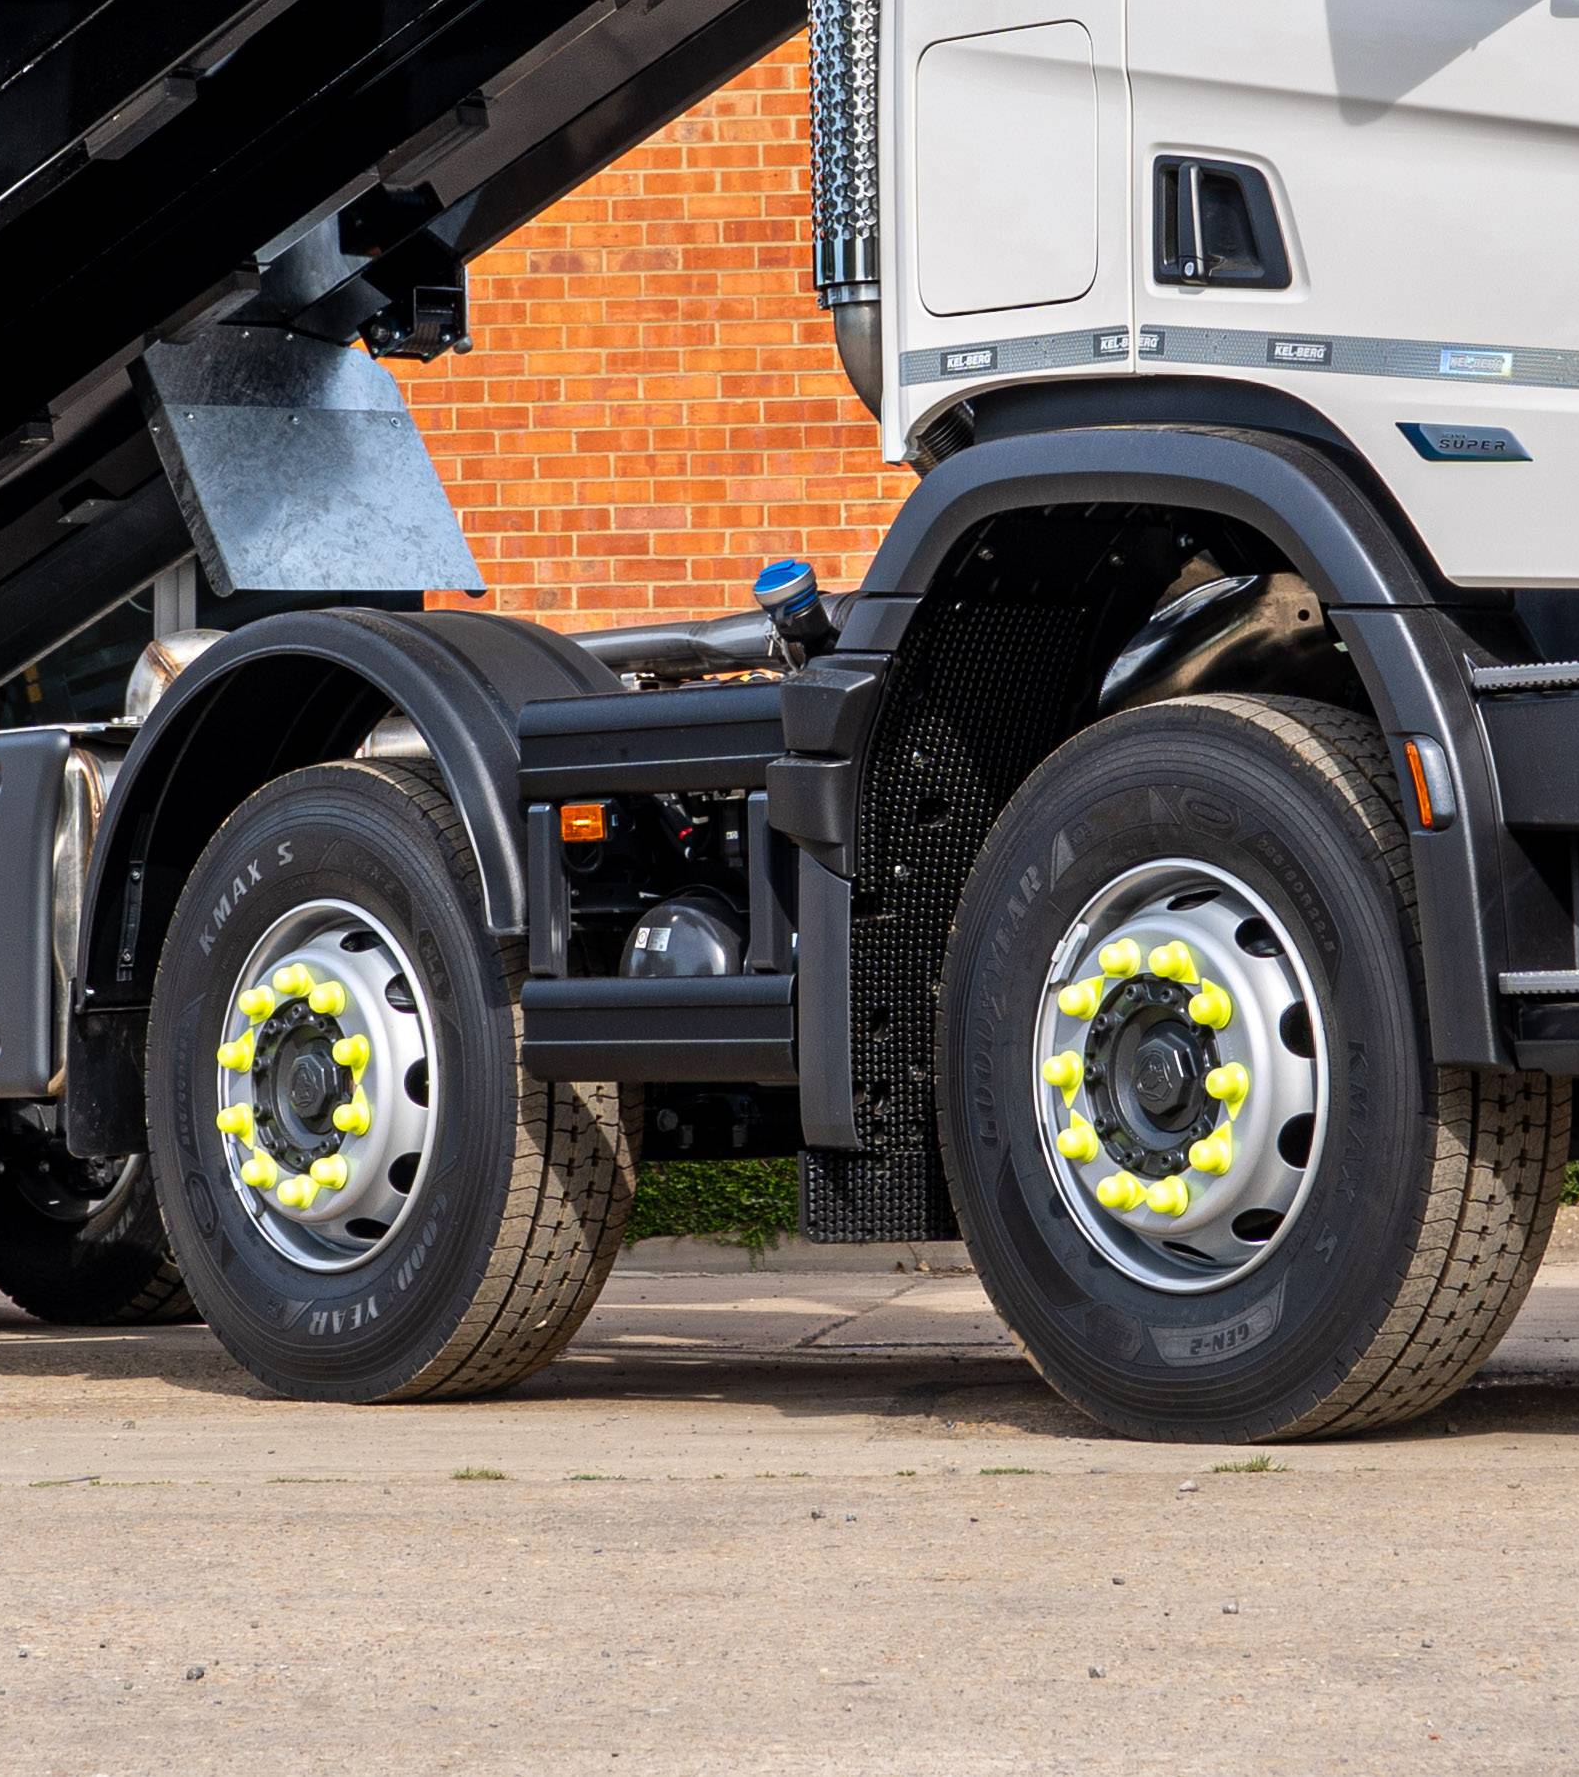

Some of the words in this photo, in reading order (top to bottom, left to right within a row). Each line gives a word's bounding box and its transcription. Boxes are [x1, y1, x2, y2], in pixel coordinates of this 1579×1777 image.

[1274, 343, 1325, 359] KEL-BERG
[946, 354, 992, 369] KEL-BERG
[1439, 439, 1506, 451] SUPER
[822, 669, 879, 692] Edbro
[198, 858, 264, 958] KMAX
[276, 840, 295, 867] S
[1189, 1322, 1250, 1357] GEN-2
